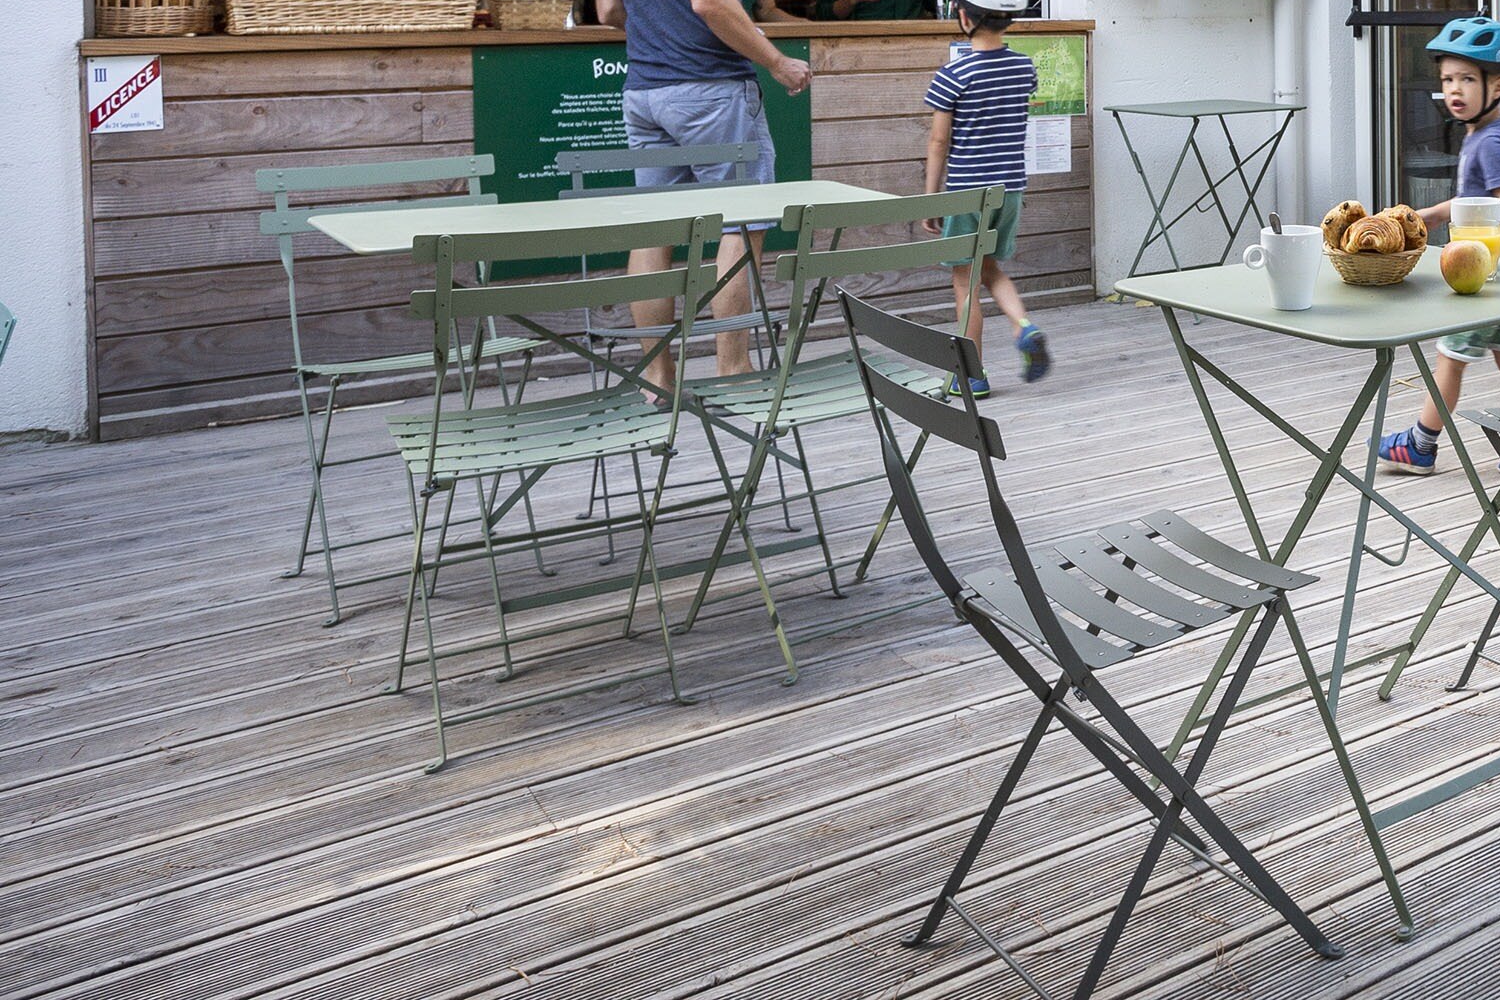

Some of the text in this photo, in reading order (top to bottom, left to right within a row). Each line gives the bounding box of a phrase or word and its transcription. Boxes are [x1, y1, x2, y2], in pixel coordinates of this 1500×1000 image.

[94, 68, 107, 83] III
[98, 65, 154, 122] LICENCE
[573, 133, 603, 142] également
